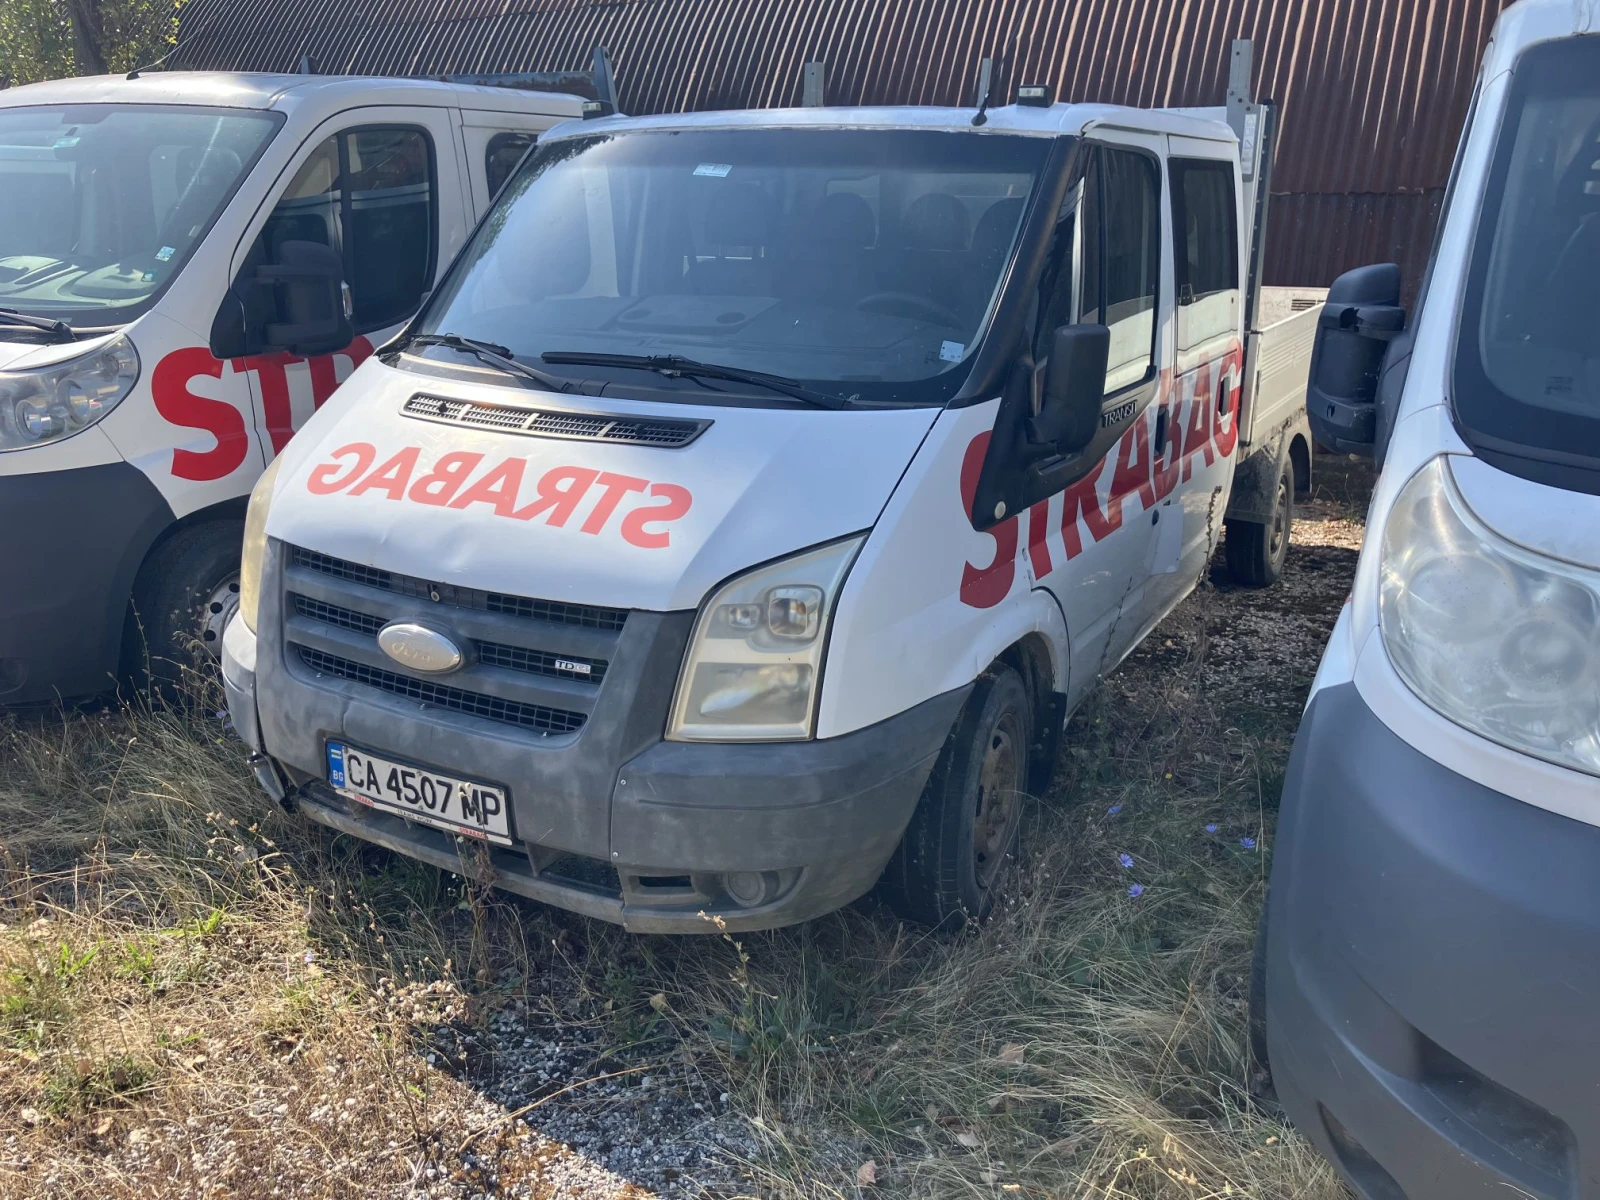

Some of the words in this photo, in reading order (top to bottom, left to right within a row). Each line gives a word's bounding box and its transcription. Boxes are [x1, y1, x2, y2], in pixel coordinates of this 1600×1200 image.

[1102, 400, 1137, 427] TRANSIT
[333, 769, 344, 782] BG
[347, 754, 381, 795] CA
[387, 767, 453, 814] 4507
[459, 784, 501, 826] MP
